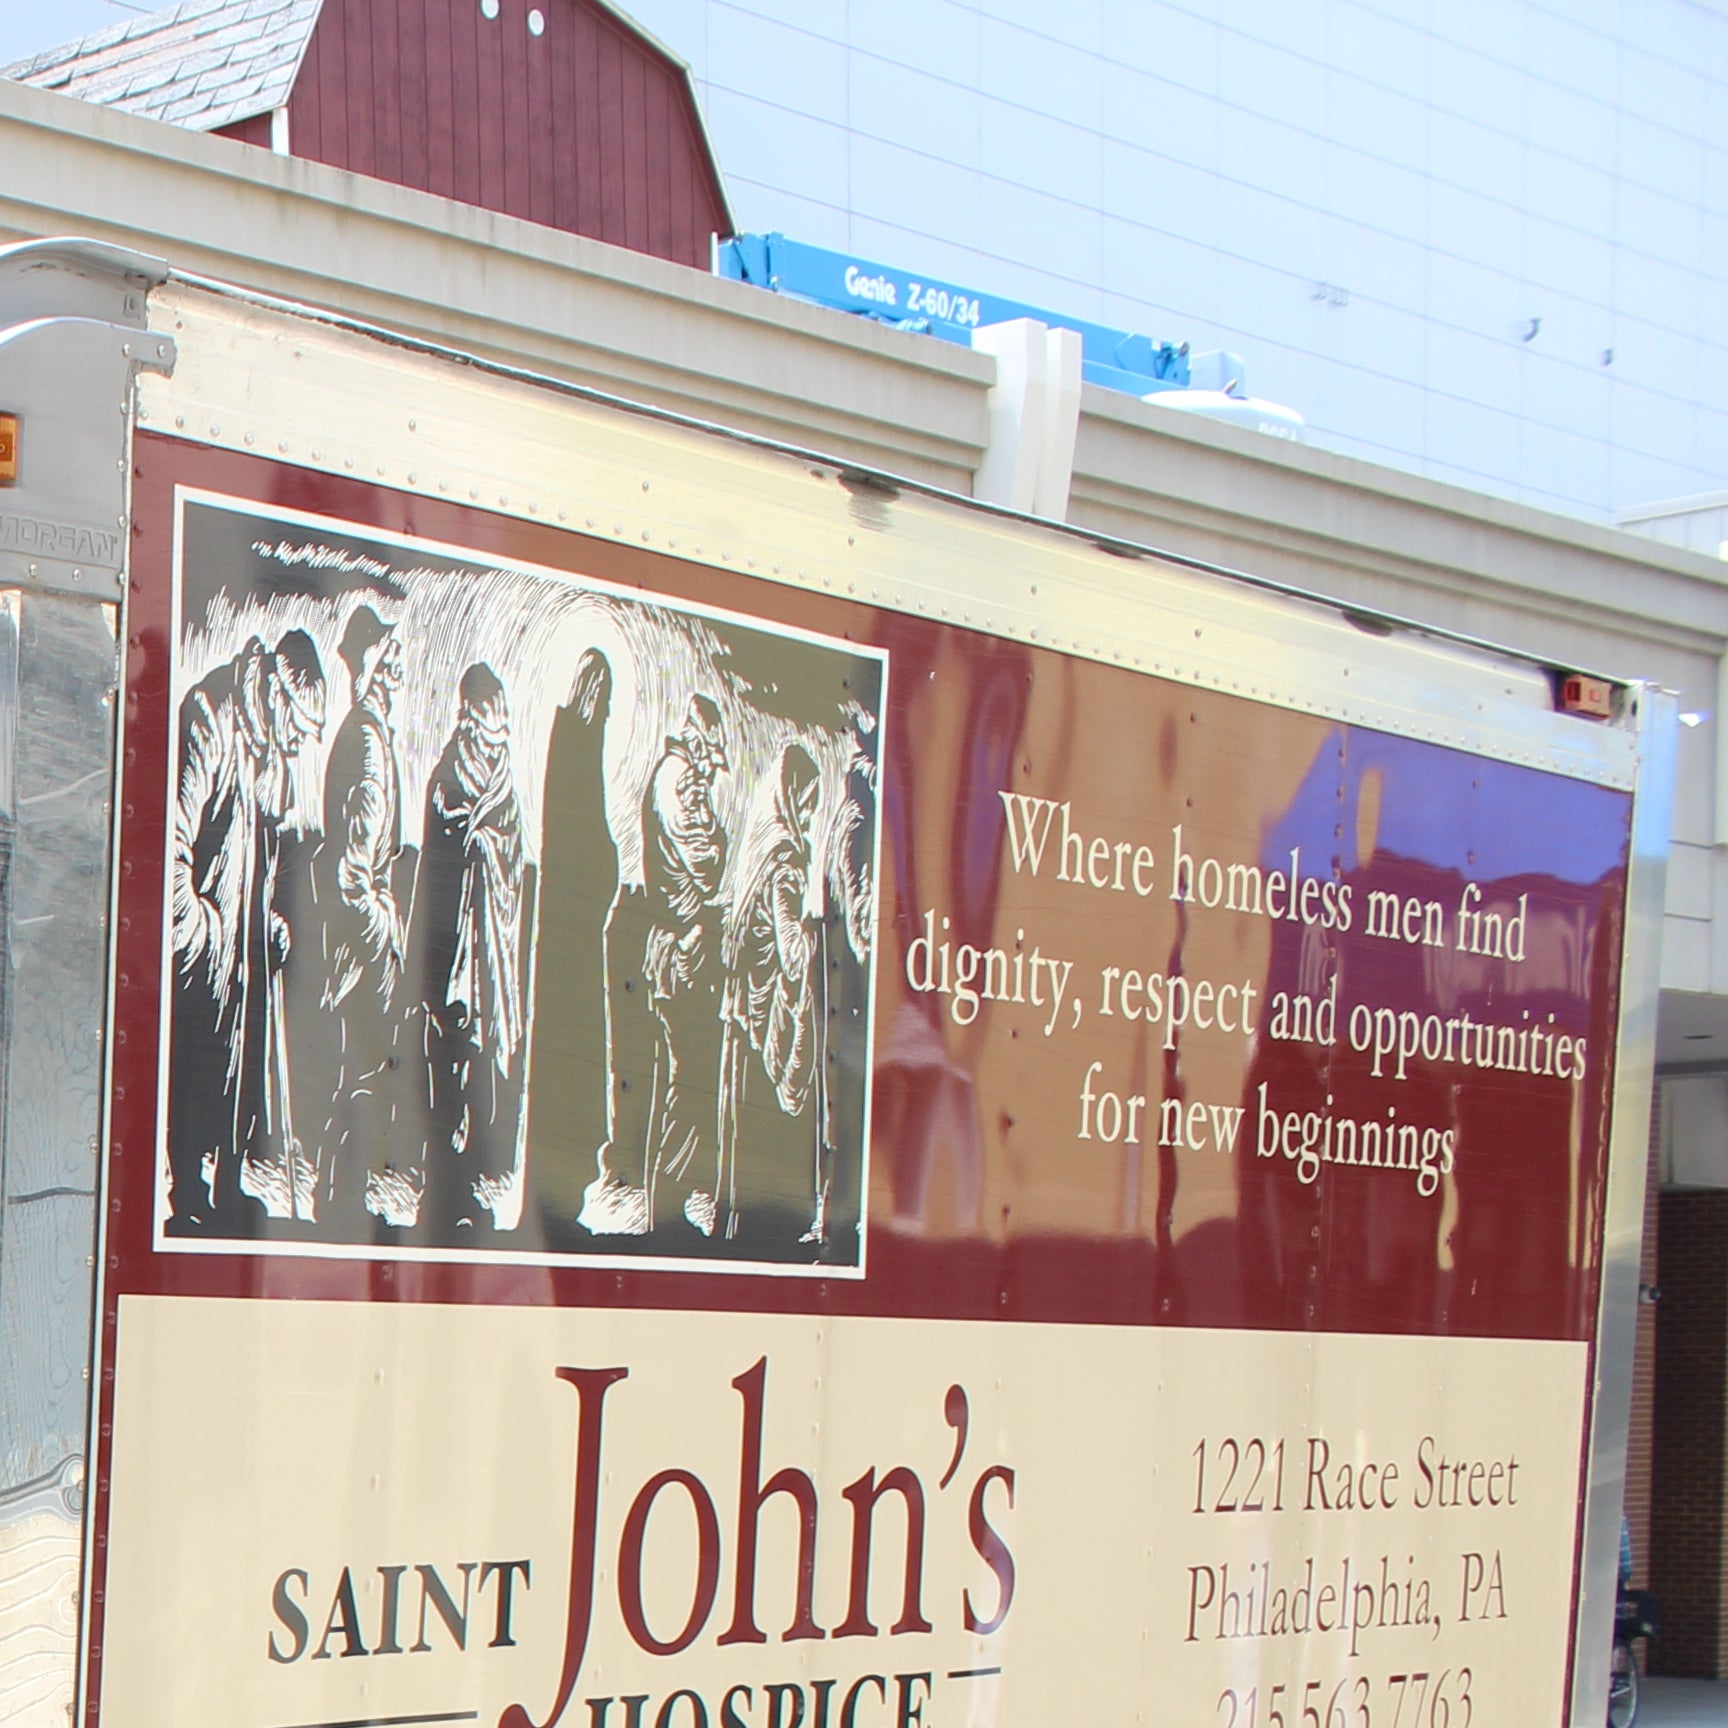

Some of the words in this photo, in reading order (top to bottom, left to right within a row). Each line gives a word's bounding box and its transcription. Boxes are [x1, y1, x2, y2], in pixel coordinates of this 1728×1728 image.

[844, 265, 897, 306] Genie
[908, 282, 980, 327] Z-60/34
[997, 790, 1154, 898] Where
[1170, 823, 1353, 932] homeless
[1365, 886, 1446, 947] men
[1455, 882, 1528, 963] find
[905, 909, 1082, 1038] dignity,
[1099, 963, 1257, 1050] respect
[1270, 975, 1337, 1050] and
[1349, 1002, 1588, 1081] opportunities
[1077, 1061, 1145, 1143] for
[1159, 1096, 1242, 1153] new
[1257, 1082, 1456, 1198] beginnings
[1191, 1437, 1286, 1514] 1221
[1304, 1437, 1399, 1511] Race
[1414, 1435, 1520, 1509] Street
[266, 1557, 532, 1664] SAINT
[1184, 1553, 1442, 1657] Philadelphia,
[1458, 1549, 1509, 1624] PA
